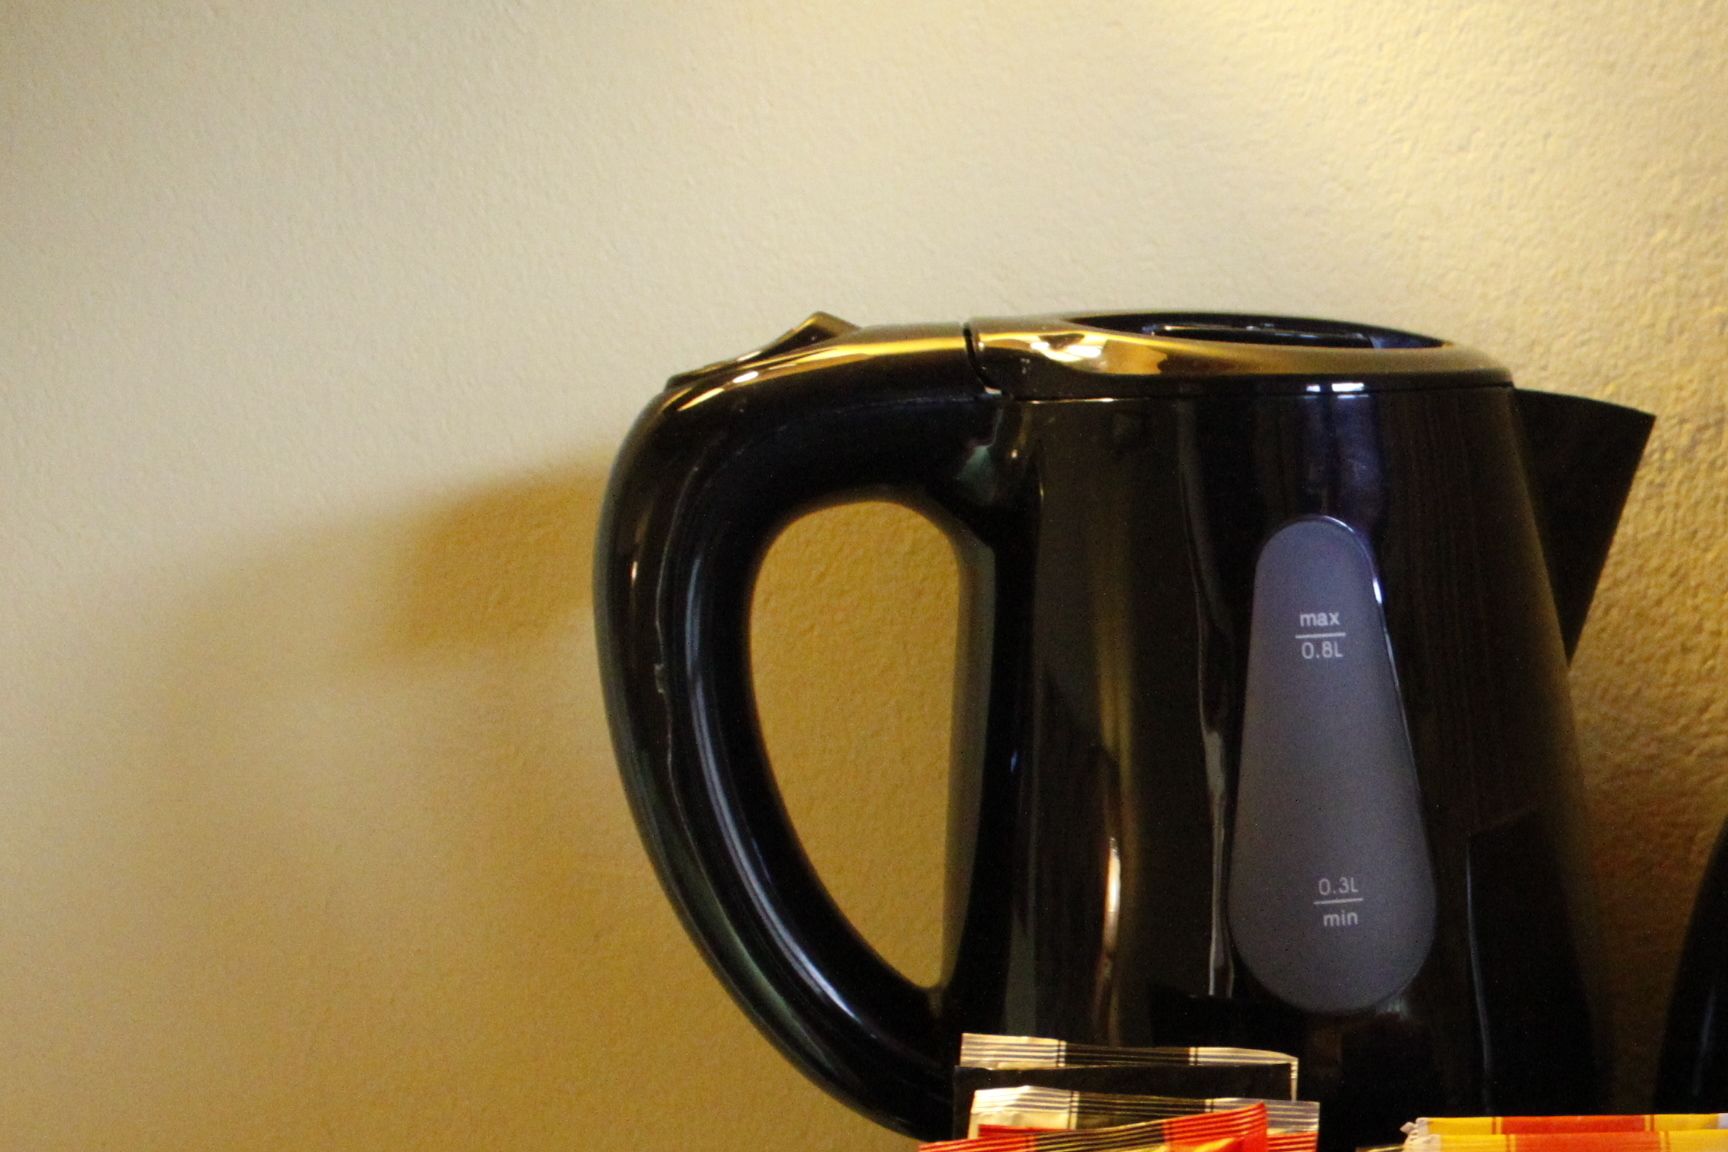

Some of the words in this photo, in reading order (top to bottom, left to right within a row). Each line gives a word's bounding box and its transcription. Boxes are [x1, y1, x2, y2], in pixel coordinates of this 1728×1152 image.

[1300, 611, 1340, 627] max
[1301, 642, 1343, 660] 0.8L
[1318, 877, 1359, 896] 0.3L
[1323, 910, 1359, 927] min
